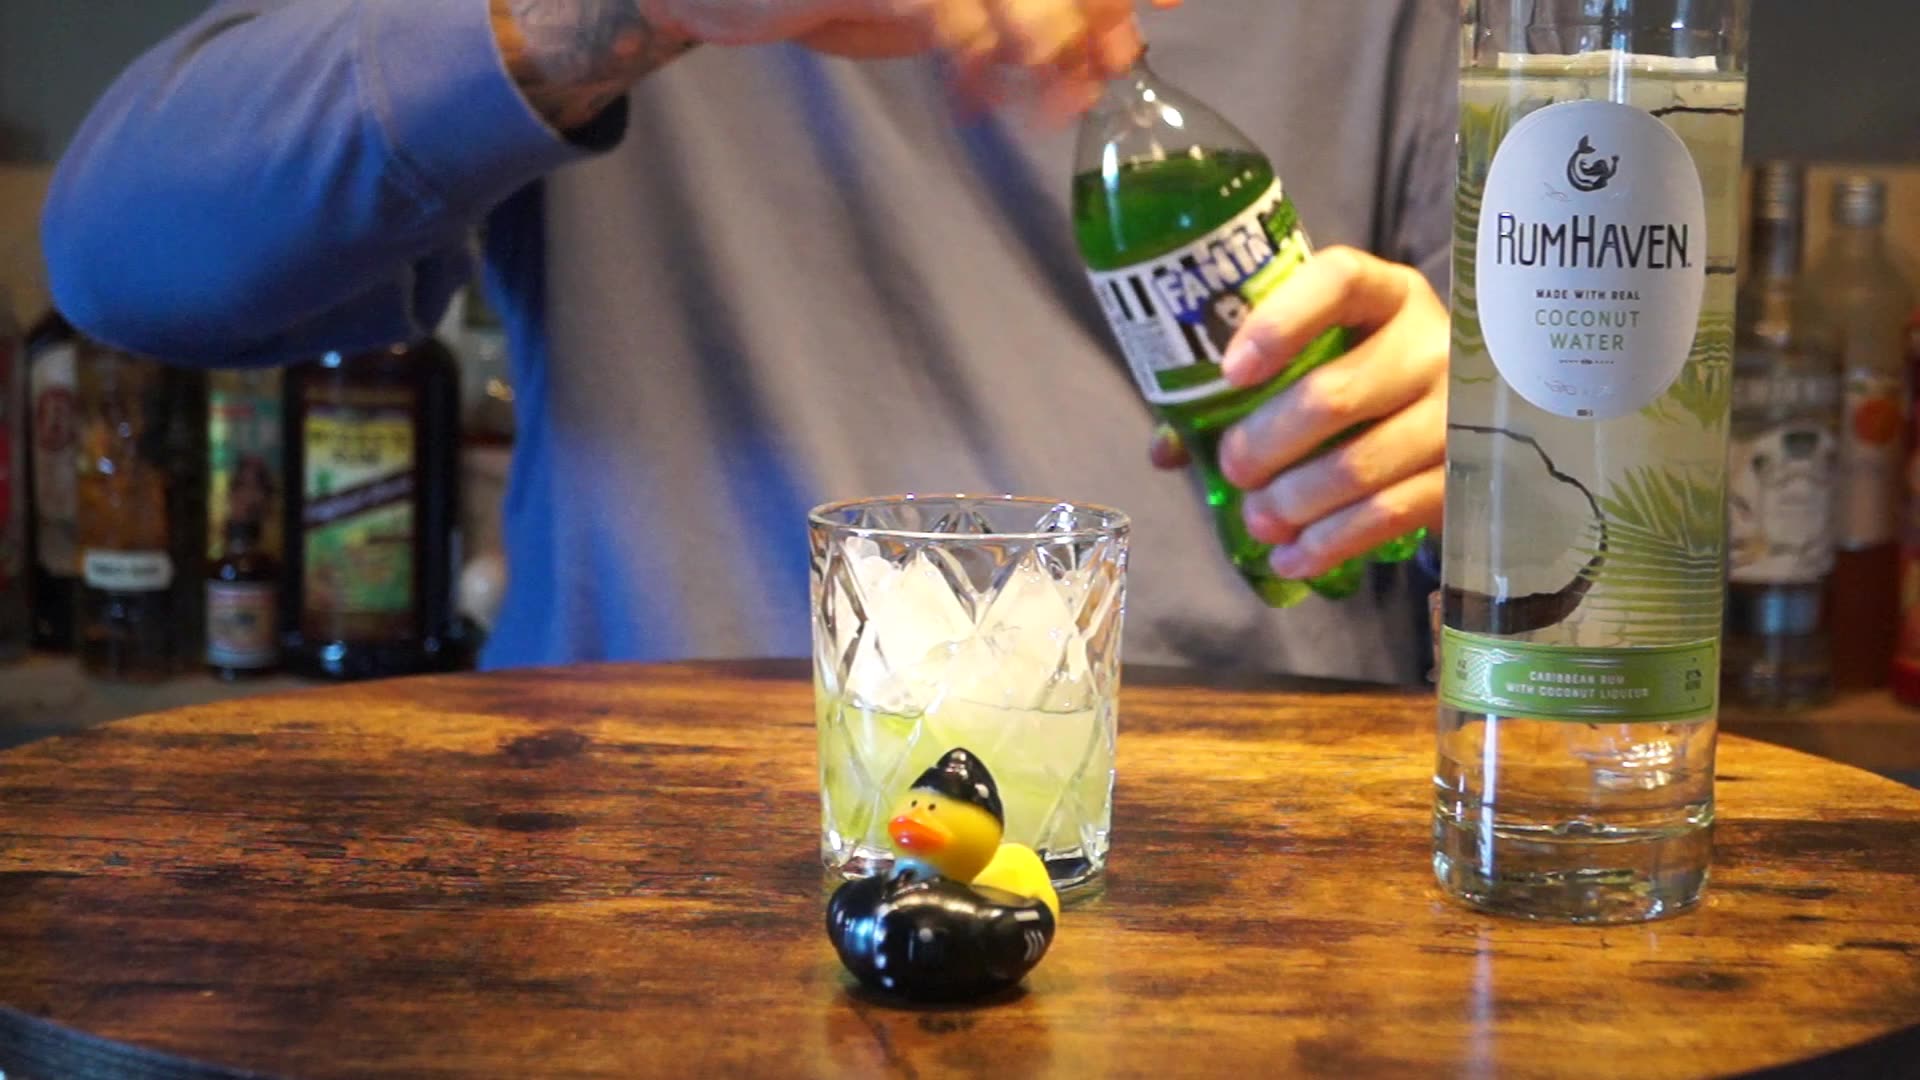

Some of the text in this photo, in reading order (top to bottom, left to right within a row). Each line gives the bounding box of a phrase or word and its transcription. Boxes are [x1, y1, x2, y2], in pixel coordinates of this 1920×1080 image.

[1153, 227, 1272, 320] FANTA
[1536, 289, 1640, 301] MADE WITH REAL
[1535, 309, 1640, 328] COCONUT
[1550, 333, 1624, 351] WATER
[1529, 671, 1625, 684] CARIBBEAN RUM
[1505, 682, 1649, 699] WITH COCONUT LIQUEUR
